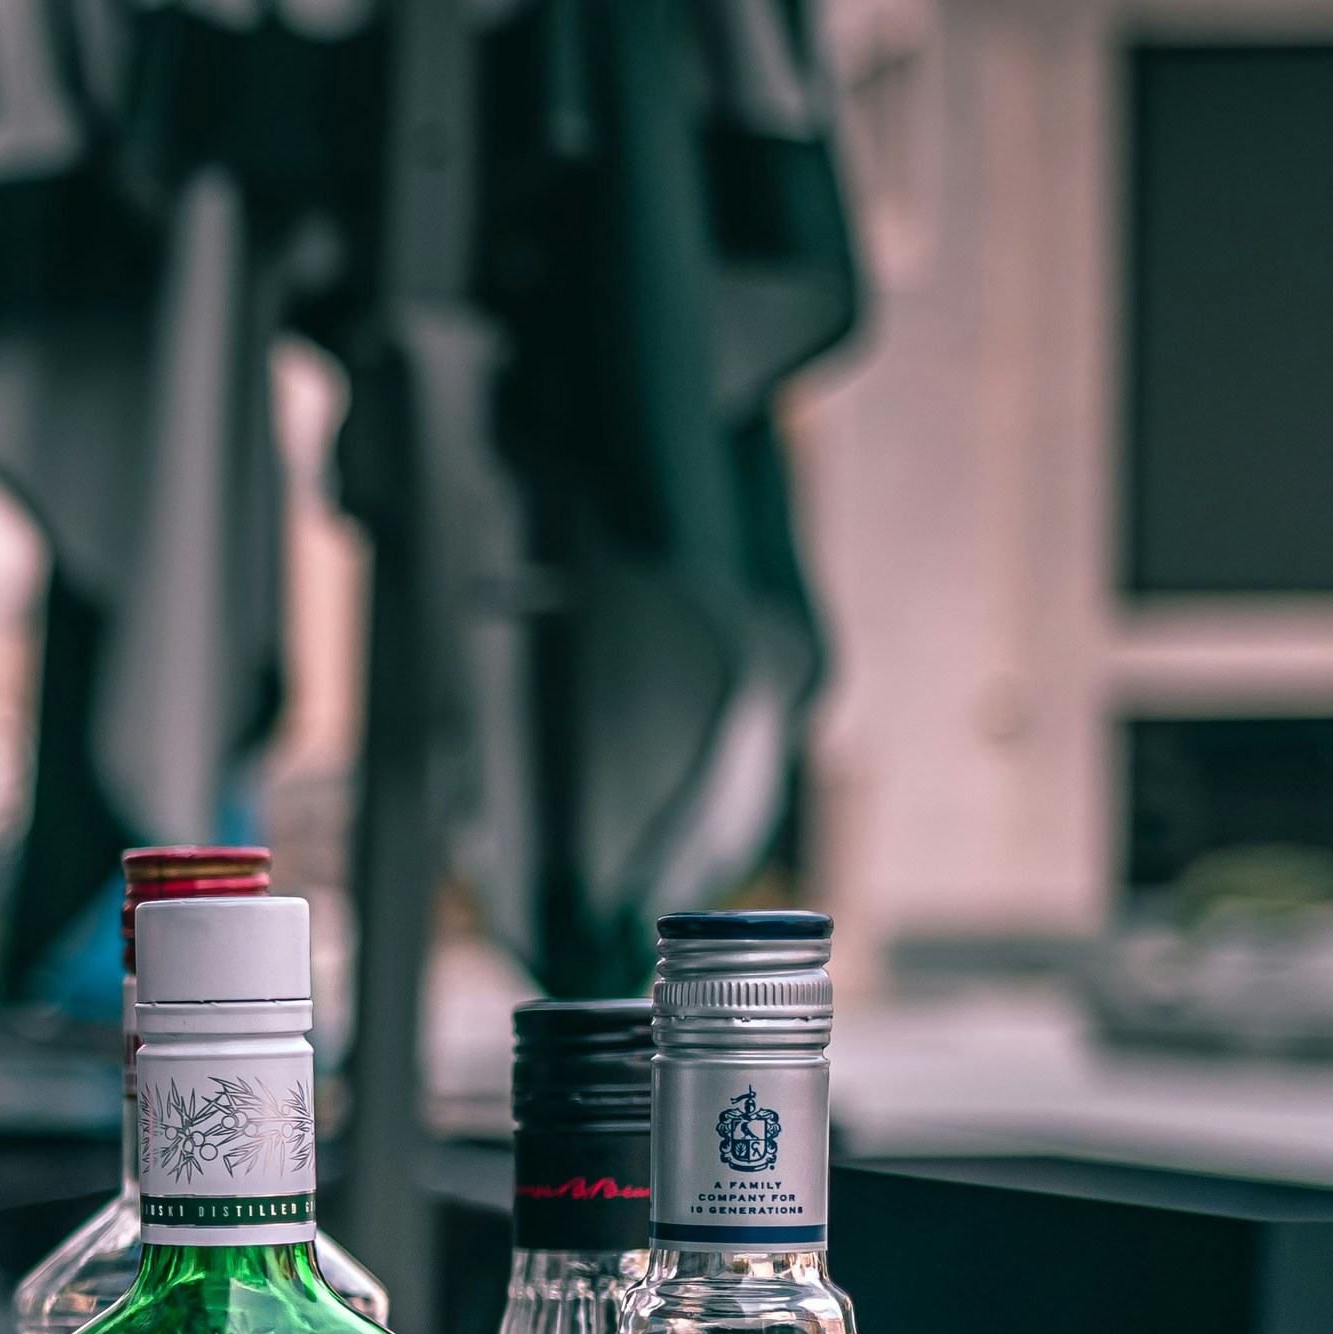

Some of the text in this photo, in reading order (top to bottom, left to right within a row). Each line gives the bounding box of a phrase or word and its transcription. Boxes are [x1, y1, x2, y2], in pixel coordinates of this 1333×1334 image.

[714, 1181, 783, 1190] A FAMILY
[698, 1193, 796, 1202] COMPANY FOR
[198, 1202, 298, 1217] DISTILLED
[690, 1205, 804, 1215] 10 GENERATIONS
